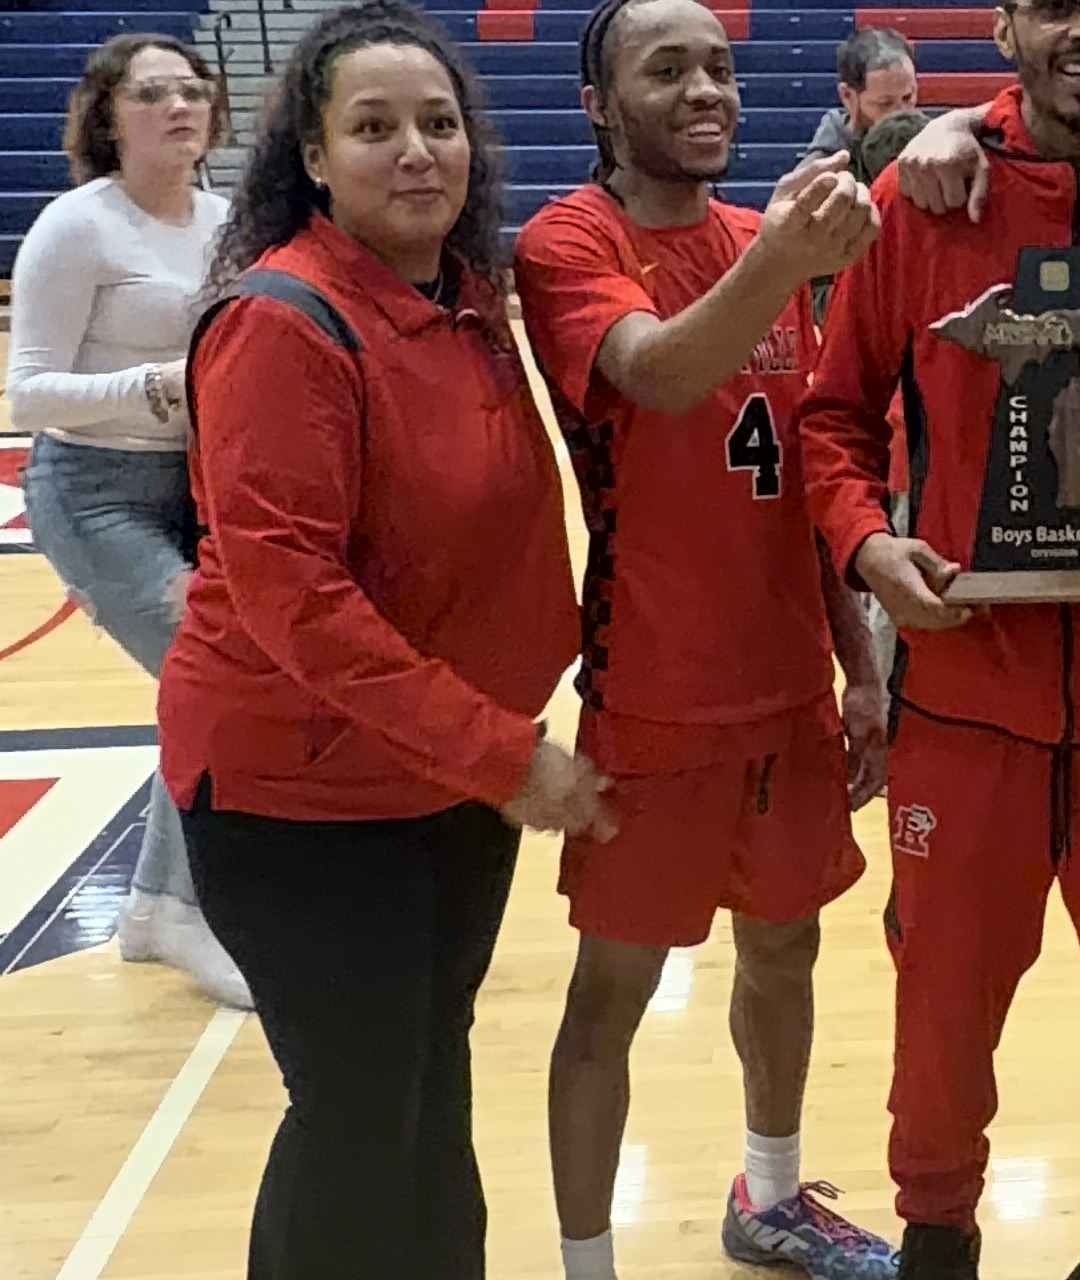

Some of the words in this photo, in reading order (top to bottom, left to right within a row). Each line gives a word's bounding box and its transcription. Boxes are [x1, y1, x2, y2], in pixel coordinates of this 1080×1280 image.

[725, 392, 783, 500] 4
[1009, 395, 1029, 512] CHAMPION
[991, 526, 1033, 547] Boys
